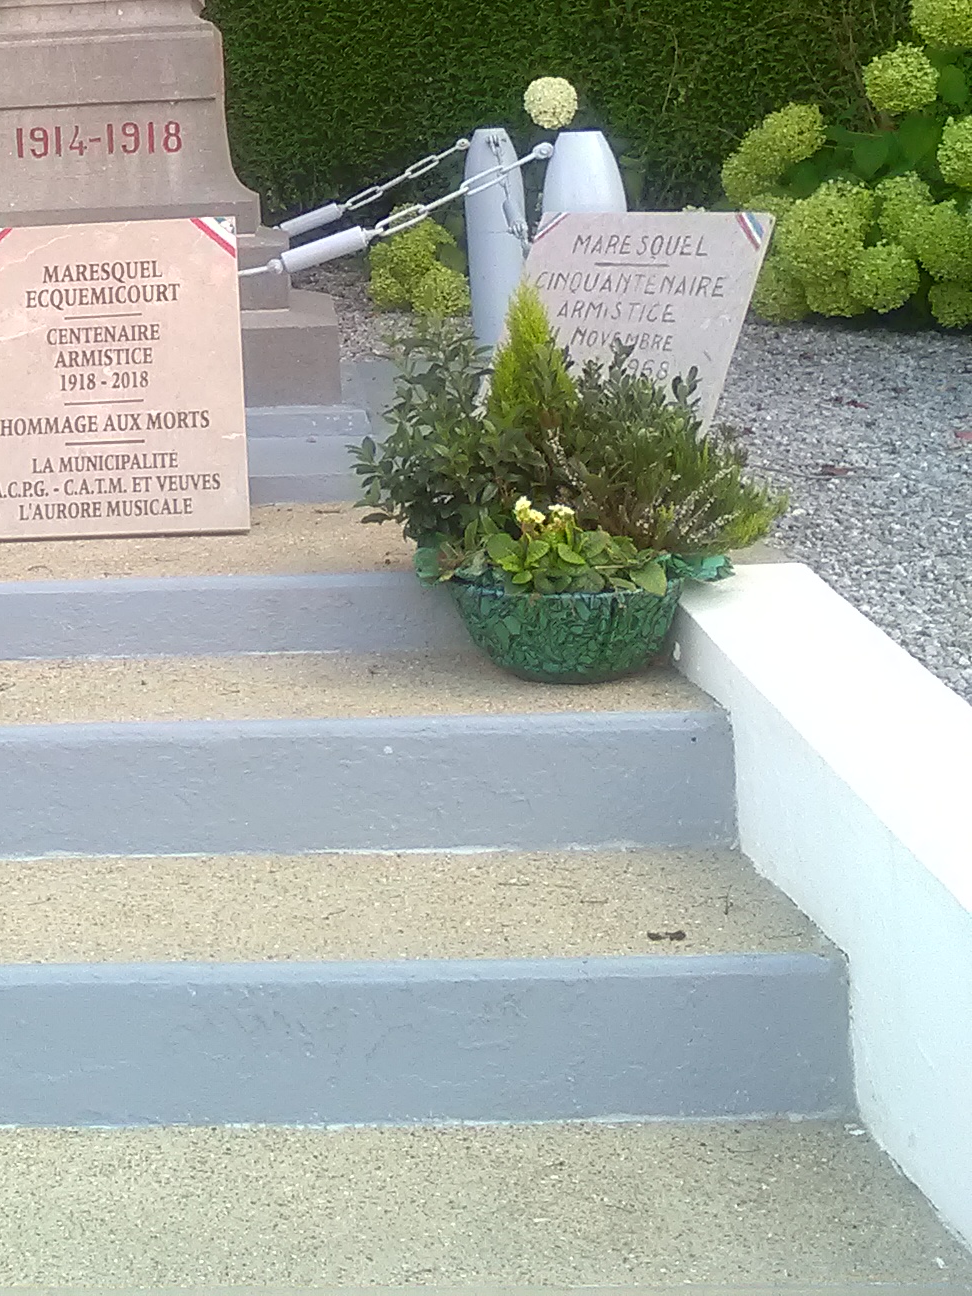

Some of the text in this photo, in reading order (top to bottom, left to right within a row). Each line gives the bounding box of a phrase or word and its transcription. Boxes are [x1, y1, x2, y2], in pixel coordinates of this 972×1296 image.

[15, 120, 183, 159] 1914-1918
[571, 234, 708, 260] MARESQUEL
[42, 260, 163, 284] MARESQUEL
[535, 270, 727, 298] CINQUANTENAIRE
[25, 283, 180, 310] ECQUEMICOURT
[46, 323, 161, 345] CENTENAIRE
[570, 326, 674, 352] NOVEMBRE
[54, 347, 153, 369] ARMISTICE
[628, 358, 670, 381] 968
[59, 372, 96, 392] 1918
[111, 370, 149, 389] 2018
[0, 410, 210, 437] HOMMAGE AUX MORTS
[32, 449, 179, 474] LA MUNICIPALITÉ
[64, 477, 127, 496] C.A.T.M.
[132, 475, 153, 492] ET
[155, 473, 221, 492] VEUVES
[19, 497, 193, 521] L'AURORE MUSICALE
